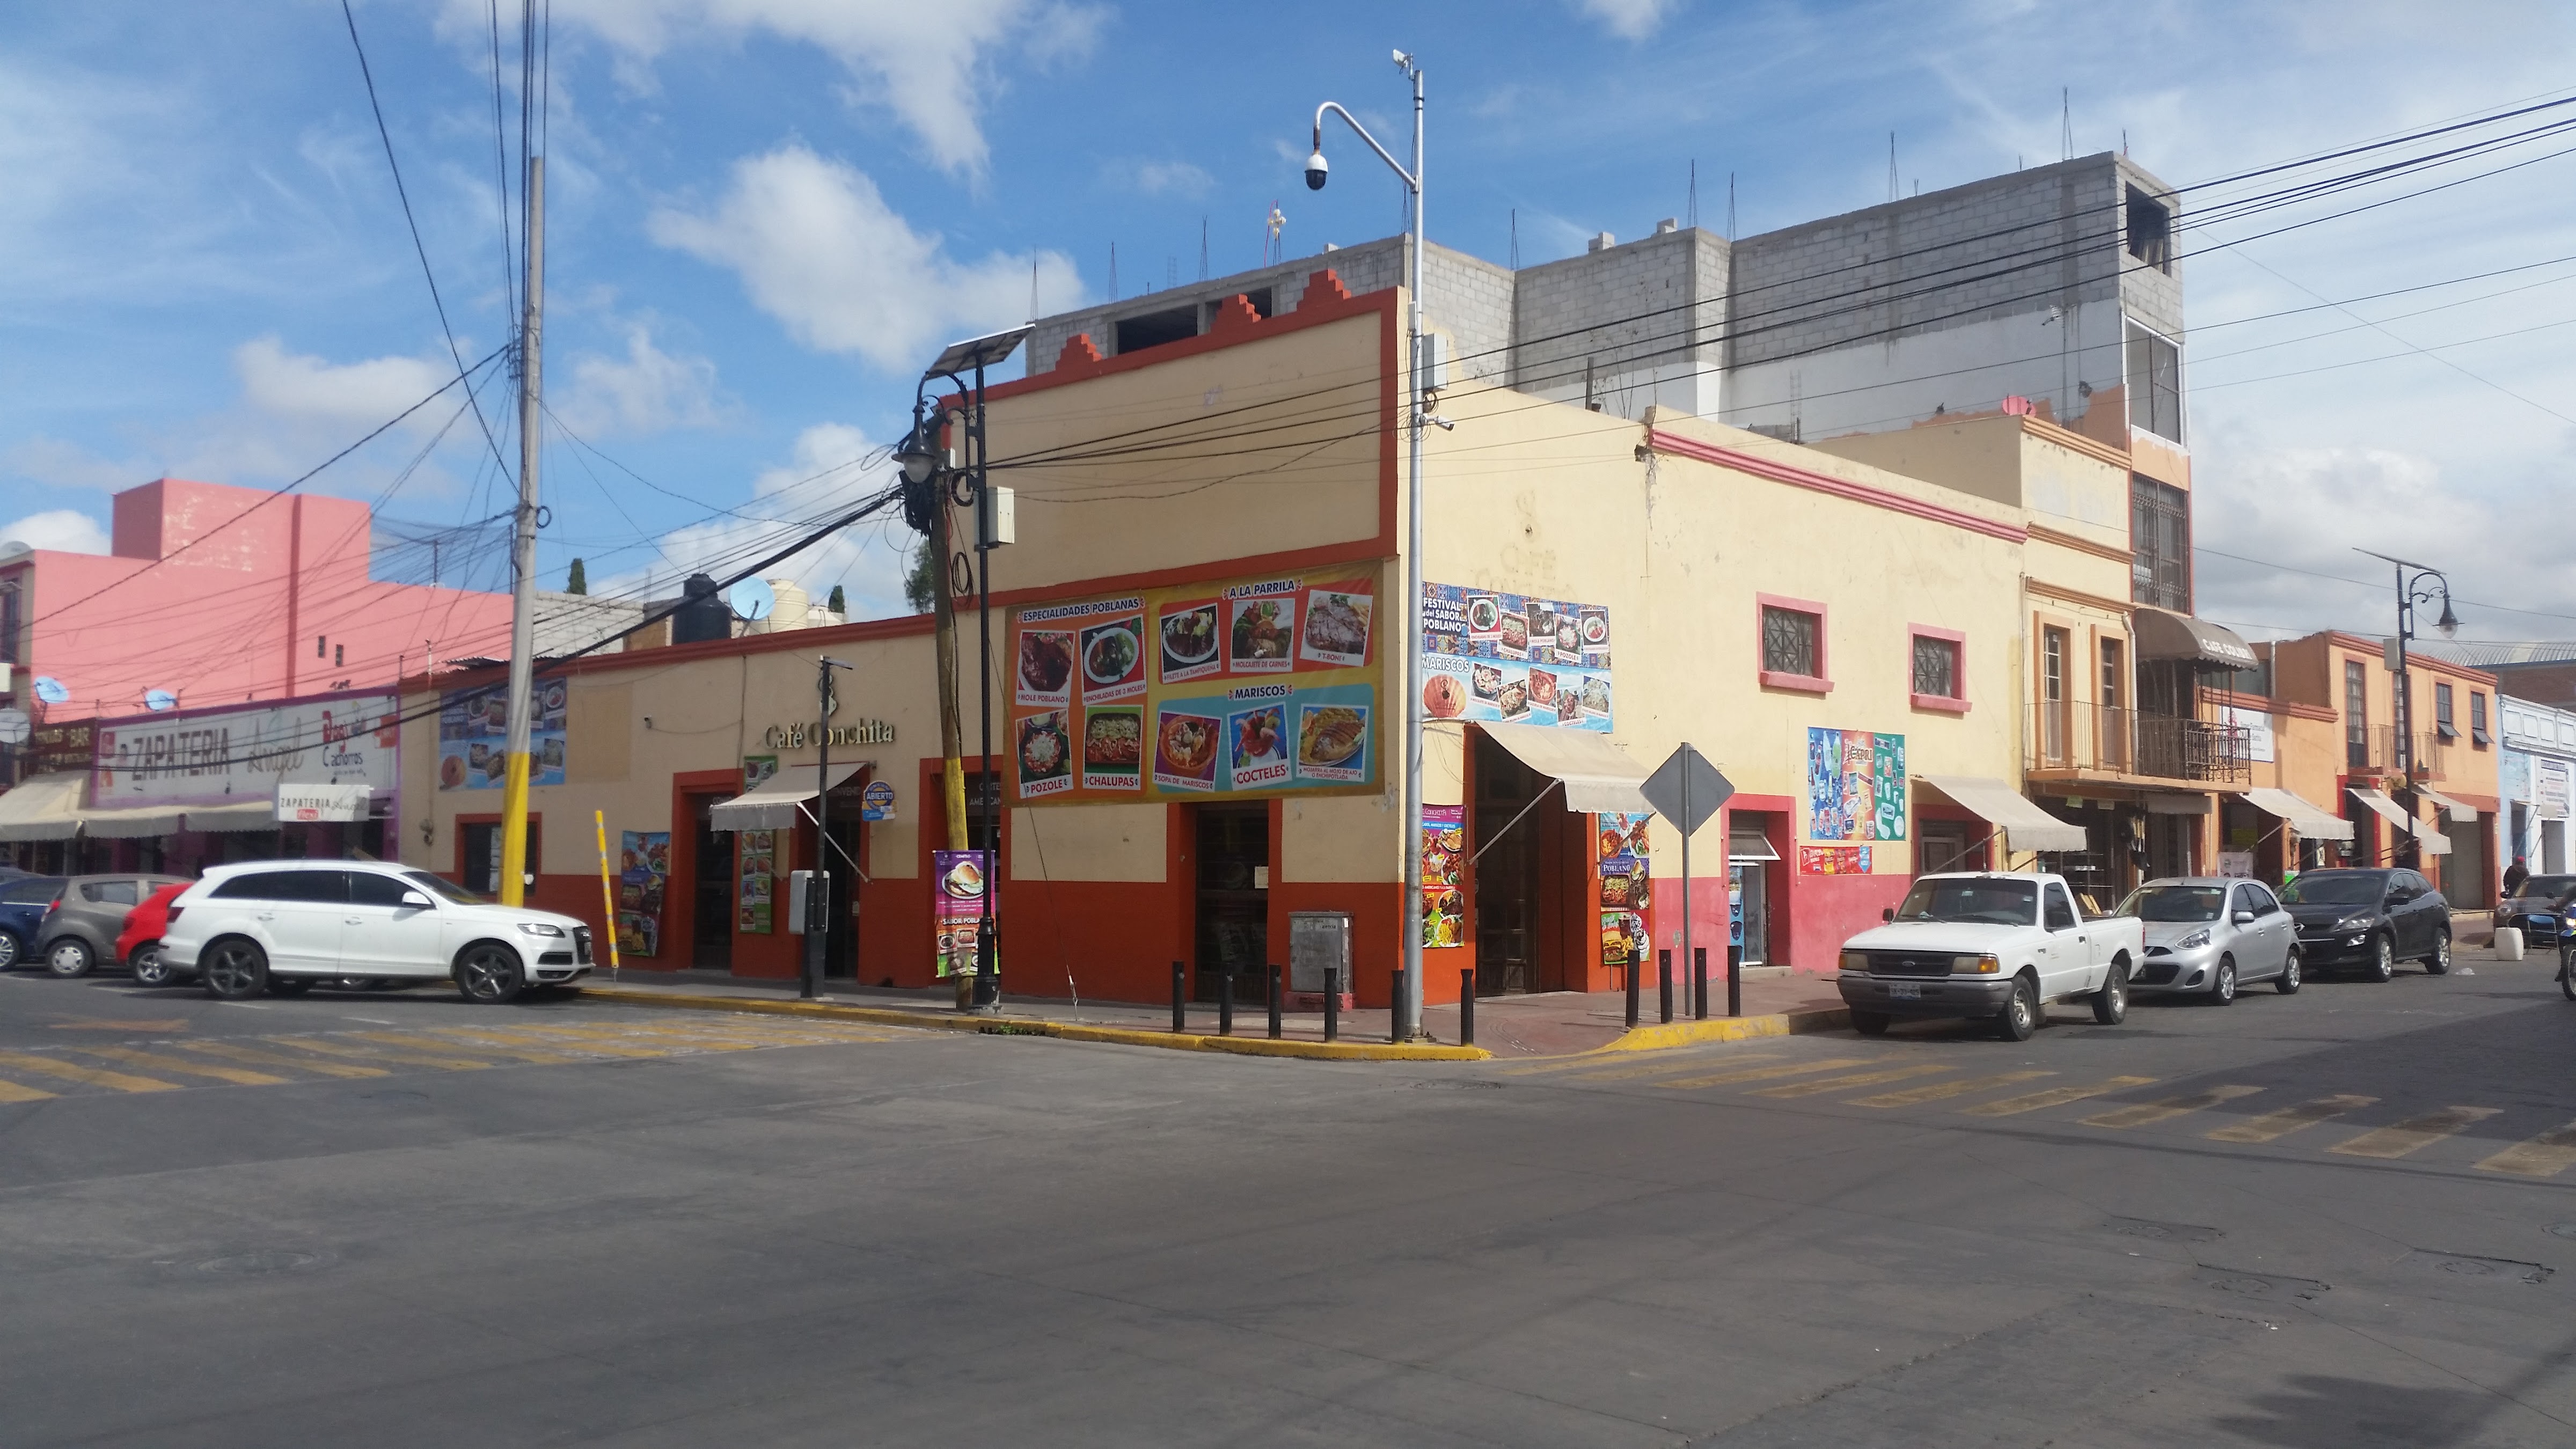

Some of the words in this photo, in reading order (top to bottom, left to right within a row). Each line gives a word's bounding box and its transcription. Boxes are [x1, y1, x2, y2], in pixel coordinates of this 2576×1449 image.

[1230, 588, 1236, 598] A
[1240, 586, 1251, 596] LA
[1254, 580, 1294, 595] PARRILA
[1023, 605, 1090, 621] ESPECIALIDADES
[1092, 598, 1139, 613] POBLANAS
[1423, 597, 1461, 612] FESTIVAL
[1426, 609, 1435, 617] del
[1435, 610, 1460, 621] SABOR
[1423, 618, 1462, 633] POBLANO
[1503, 647, 1522, 657] CHALUPAS
[1560, 653, 1577, 661] POZOLE
[1422, 656, 1470, 672] MARISCOS
[1038, 695, 1065, 703] POBLANO
[1086, 690, 1115, 702] ENCHILADAS
[1127, 685, 1143, 693] MOLES
[1235, 685, 1285, 699] MARISCOS
[765, 722, 803, 750] Café
[807, 718, 895, 748] Conchita
[132, 727, 231, 781] ZAPATERIA
[247, 717, 304, 784] Angel
[1850, 746, 1872, 760] CAPRI
[1236, 764, 1286, 784] COCTELES
[1030, 779, 1063, 794] POZOLE
[1089, 776, 1134, 787] CHALUPAS
[1158, 775, 1172, 784] SOPA
[1182, 779, 1209, 789] MARISCOS
[281, 797, 330, 808] ZAPATERIA
[866, 792, 894, 800] ABIERTO
